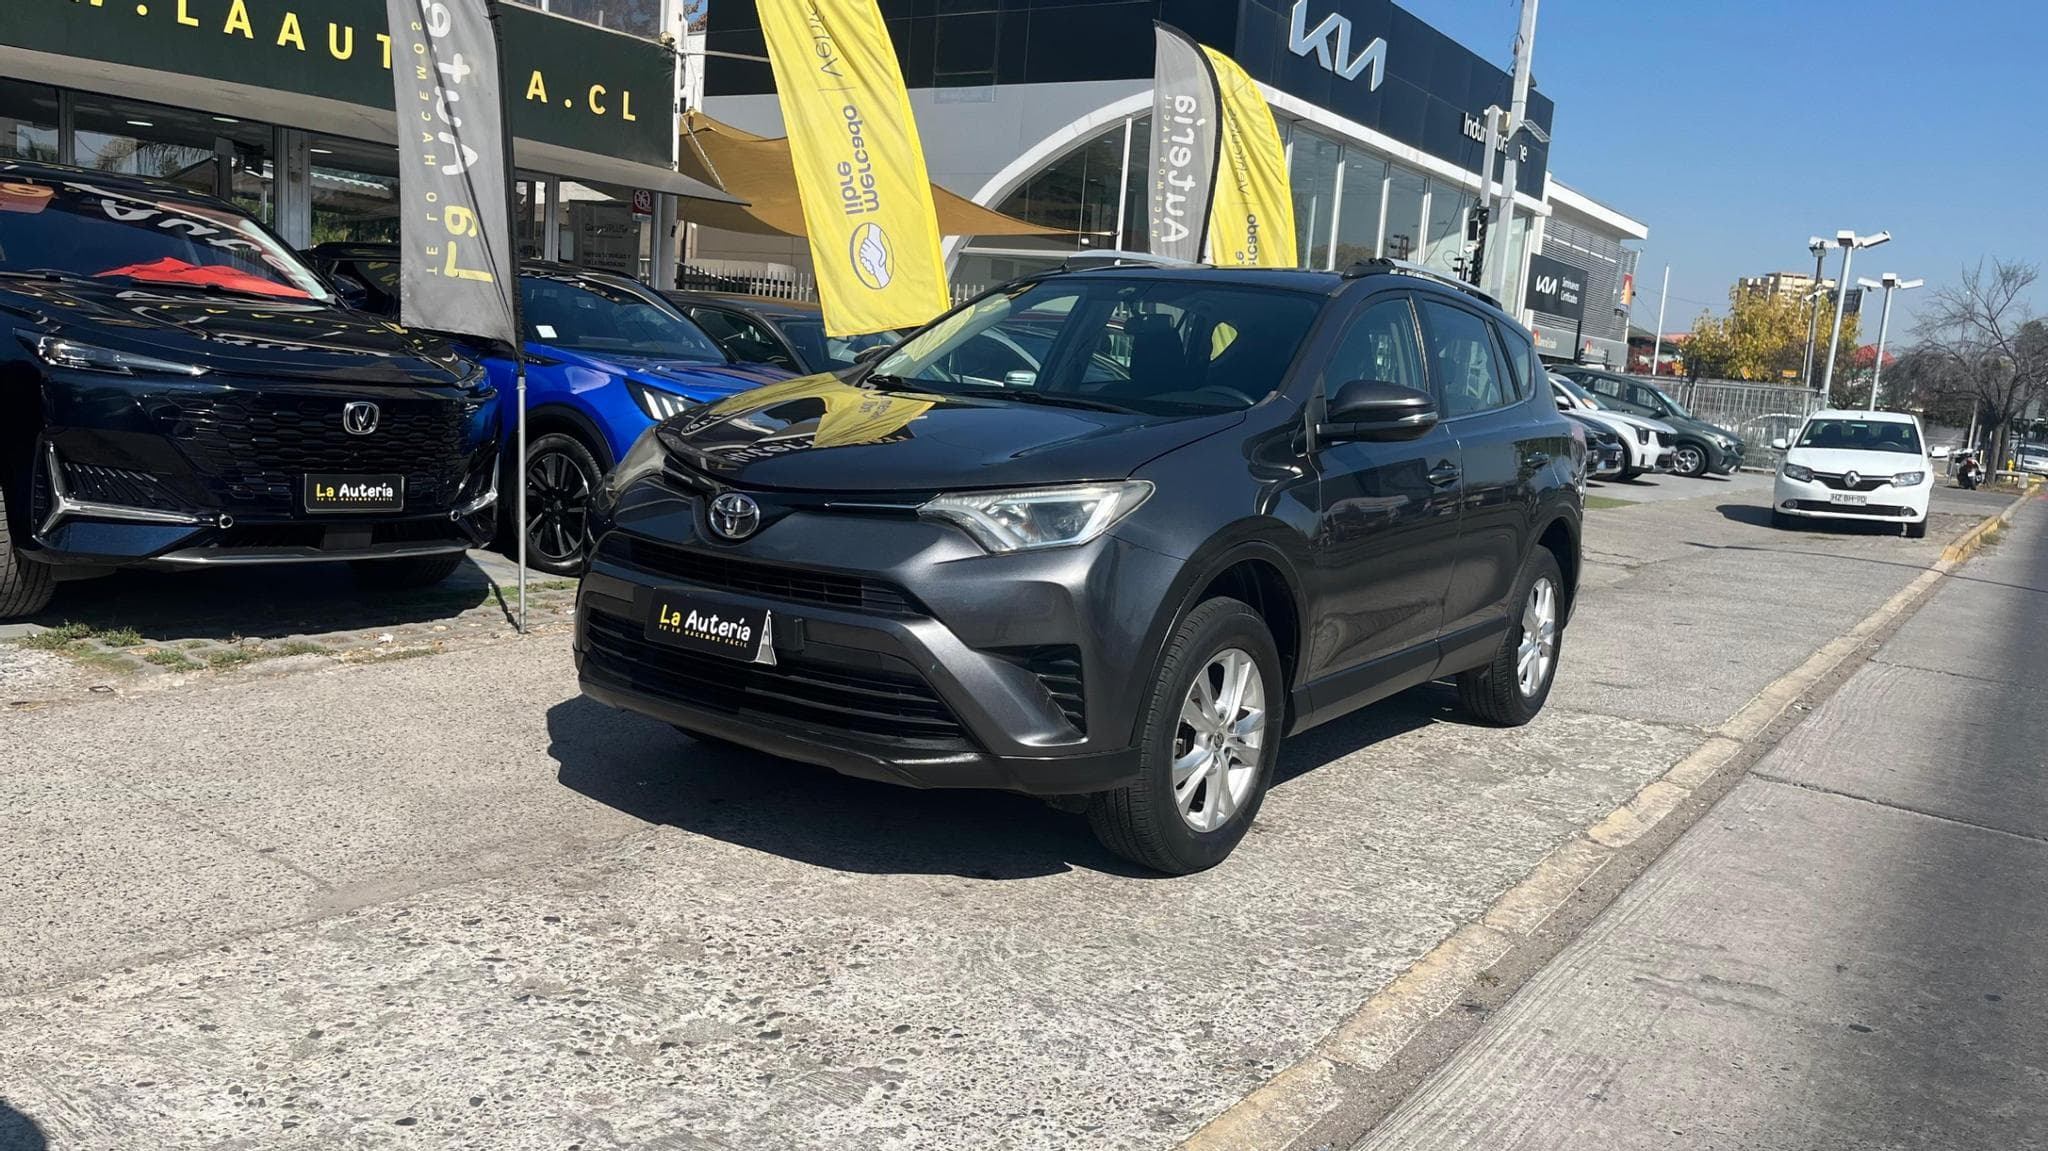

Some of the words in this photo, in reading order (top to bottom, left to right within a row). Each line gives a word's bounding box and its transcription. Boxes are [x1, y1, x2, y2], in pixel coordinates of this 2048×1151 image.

[316, 483, 334, 497] La
[339, 482, 393, 497] Autería
[660, 604, 681, 627] La
[684, 609, 751, 641] Autería
